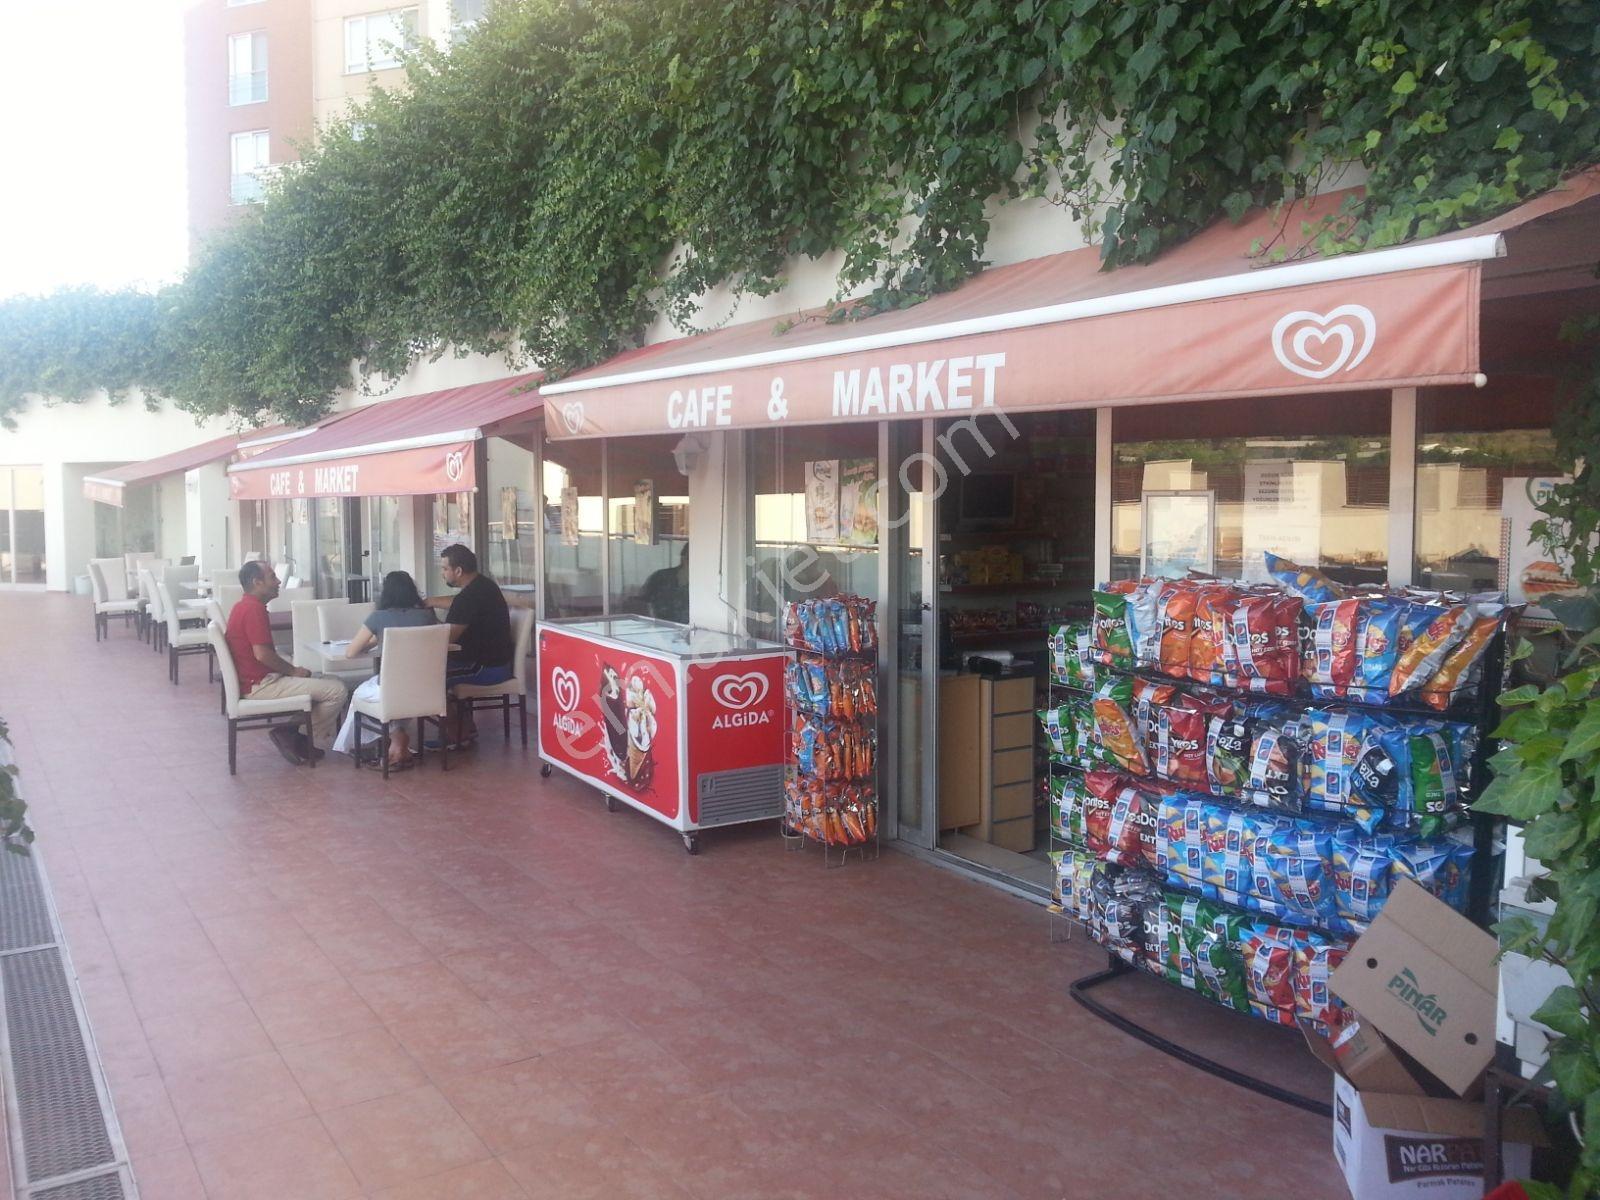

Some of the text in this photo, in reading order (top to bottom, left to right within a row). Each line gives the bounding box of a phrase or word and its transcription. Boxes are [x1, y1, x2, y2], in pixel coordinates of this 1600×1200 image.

[667, 352, 1006, 429] CAFE & MARKET
[270, 464, 359, 495] CAFE & MARKET
